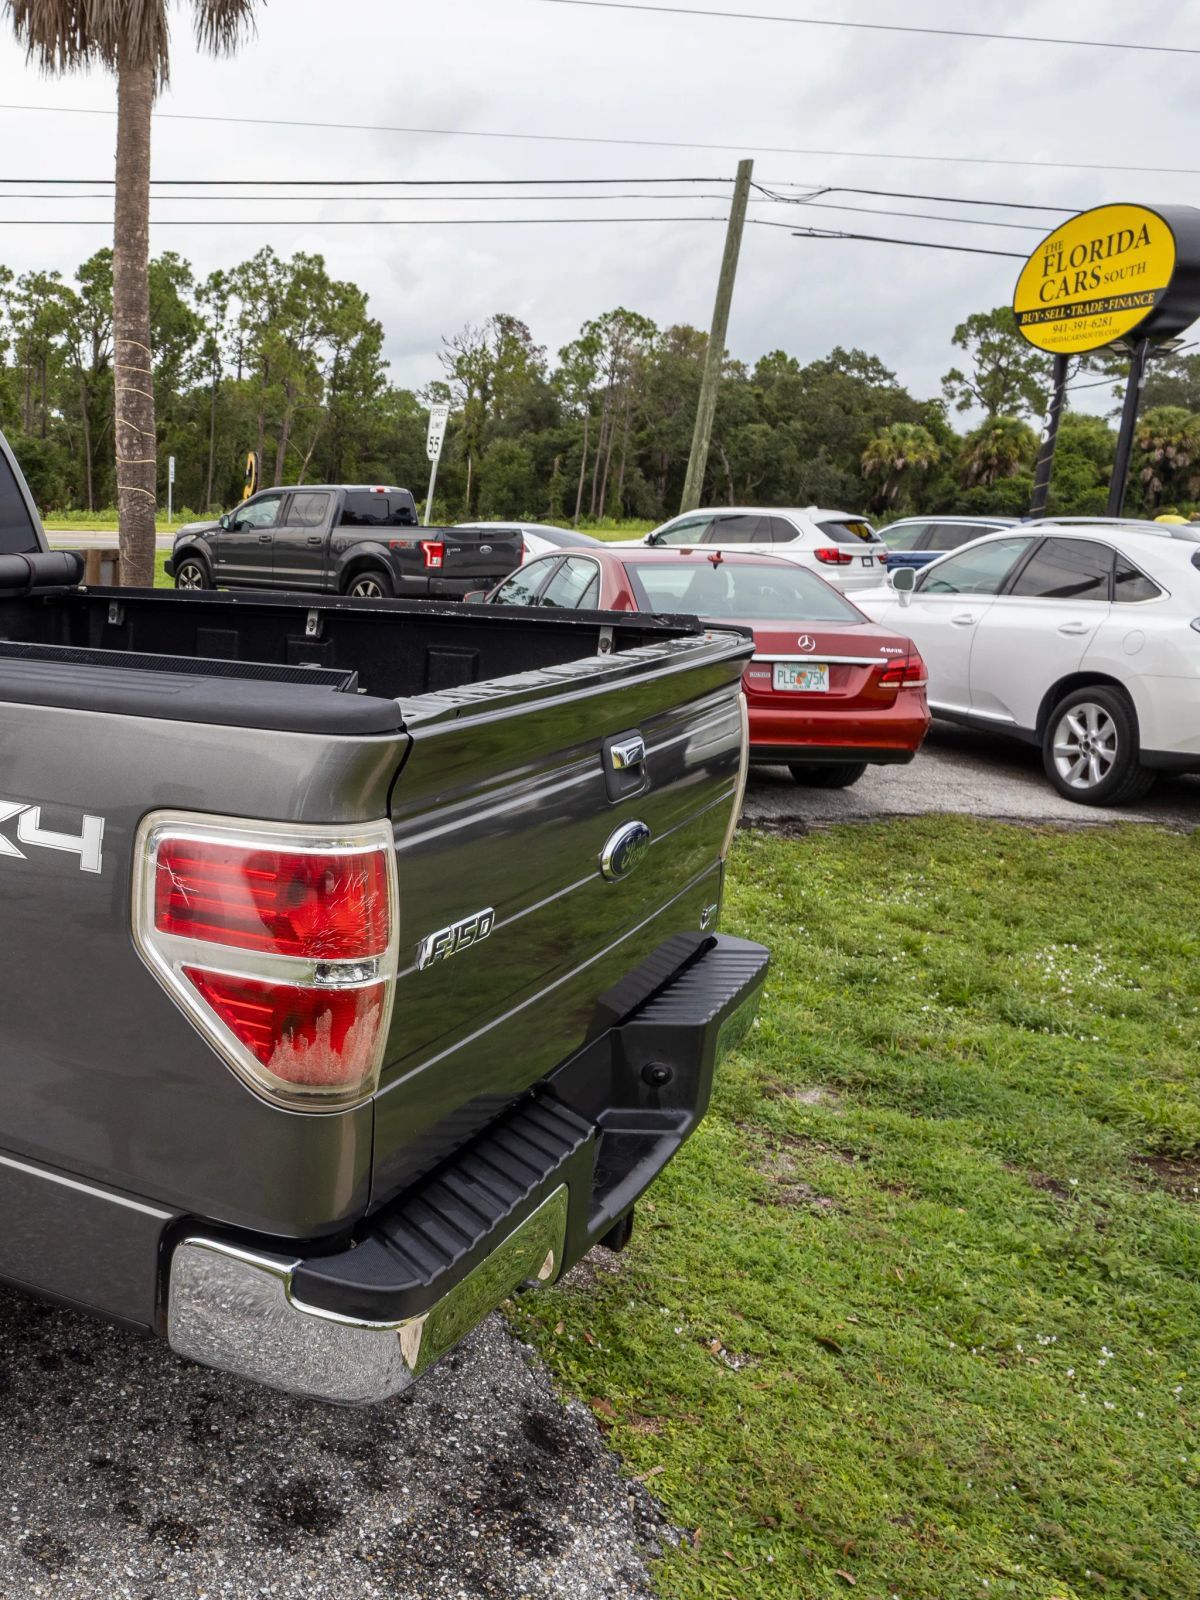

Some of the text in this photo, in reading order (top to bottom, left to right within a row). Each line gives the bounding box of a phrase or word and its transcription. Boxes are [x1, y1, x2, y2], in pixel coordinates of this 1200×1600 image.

[1041, 223, 1152, 278] FLORIDA
[1044, 240, 1064, 254] THE
[1039, 262, 1146, 303] CARS SOUTH
[1021, 292, 1155, 324] BUY SELL TRADE FINANCE
[1052, 316, 1113, 334] 941-391-6281
[428, 436, 441, 454] 55
